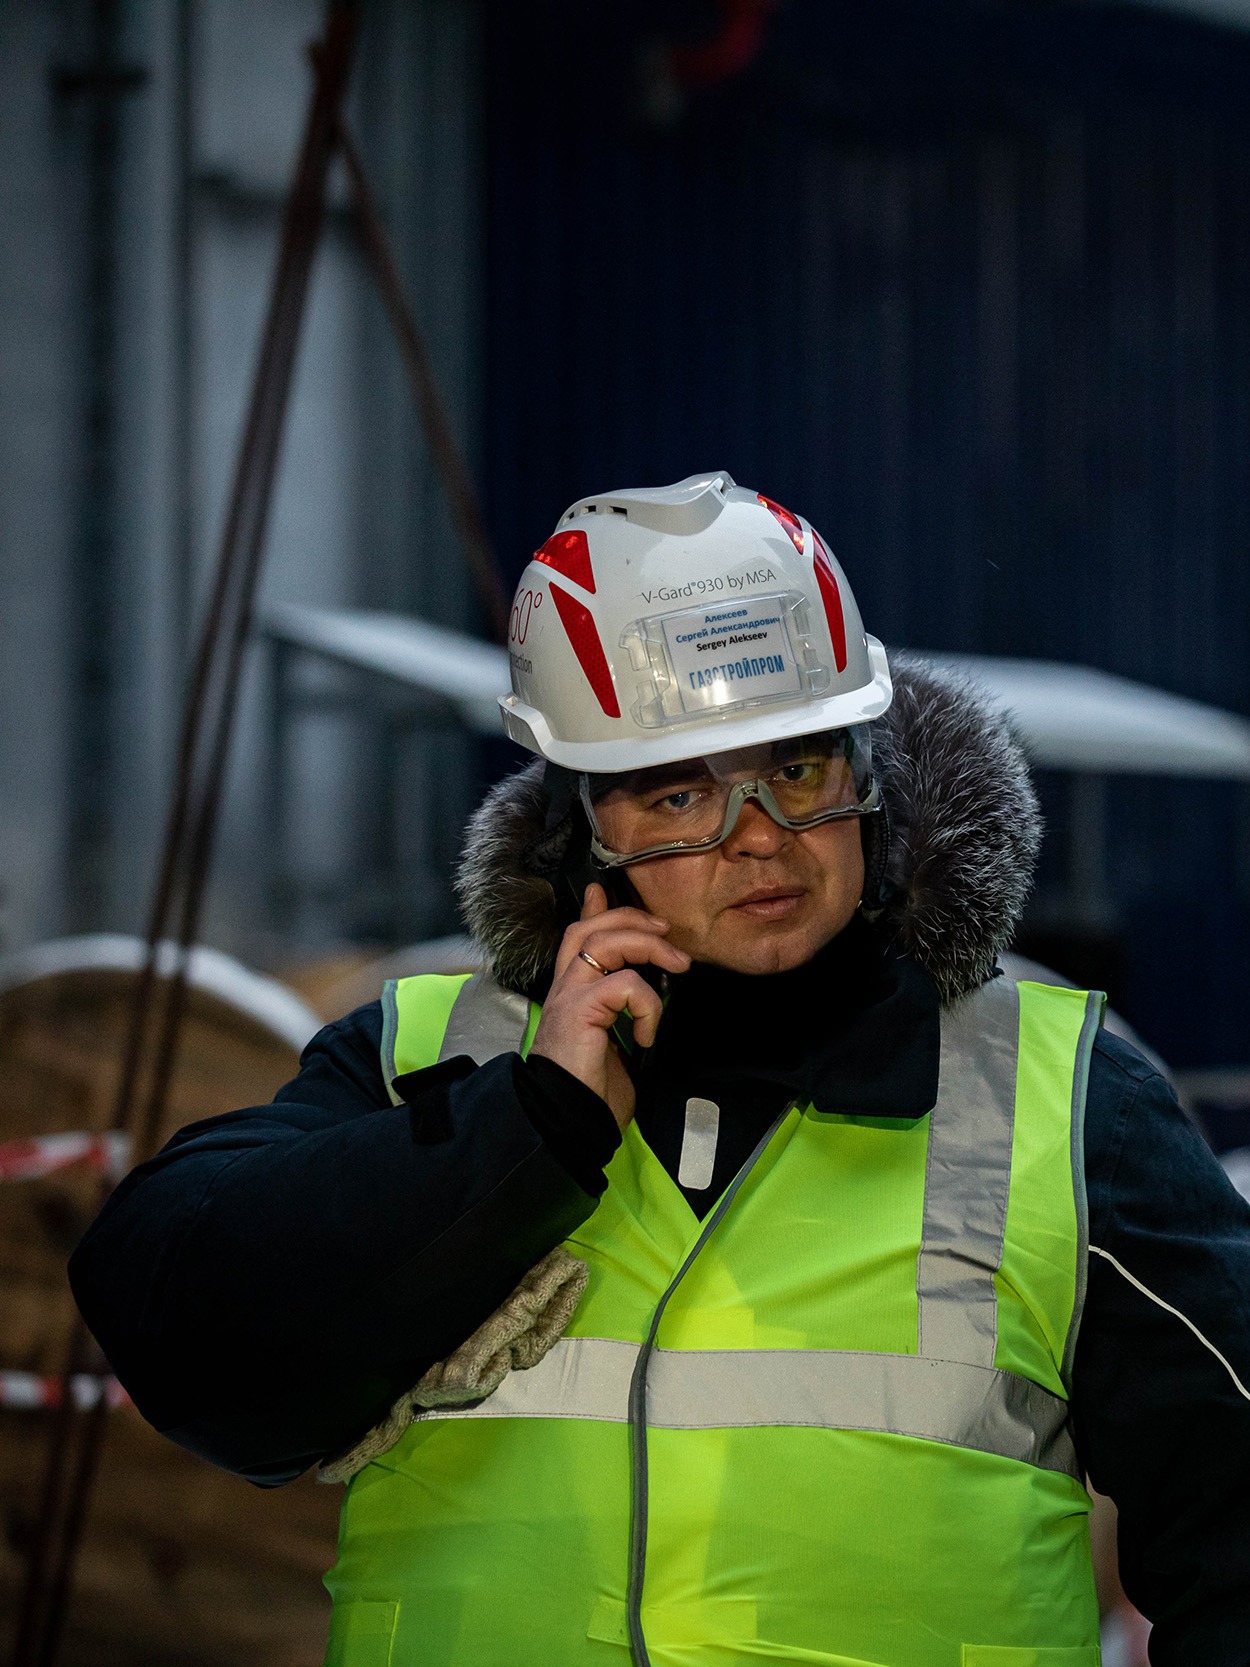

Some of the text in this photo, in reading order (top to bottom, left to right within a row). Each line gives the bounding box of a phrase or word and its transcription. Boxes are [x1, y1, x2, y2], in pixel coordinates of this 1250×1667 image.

[726, 575, 744, 590] by
[746, 569, 777, 585] MSA
[704, 609, 748, 623] Алексеев
[675, 616, 781, 644] Сергей Александрович
[696, 631, 768, 652] Sergey Alekseev
[688, 654, 785, 690] ГАЗСТРОЙПРОМ
